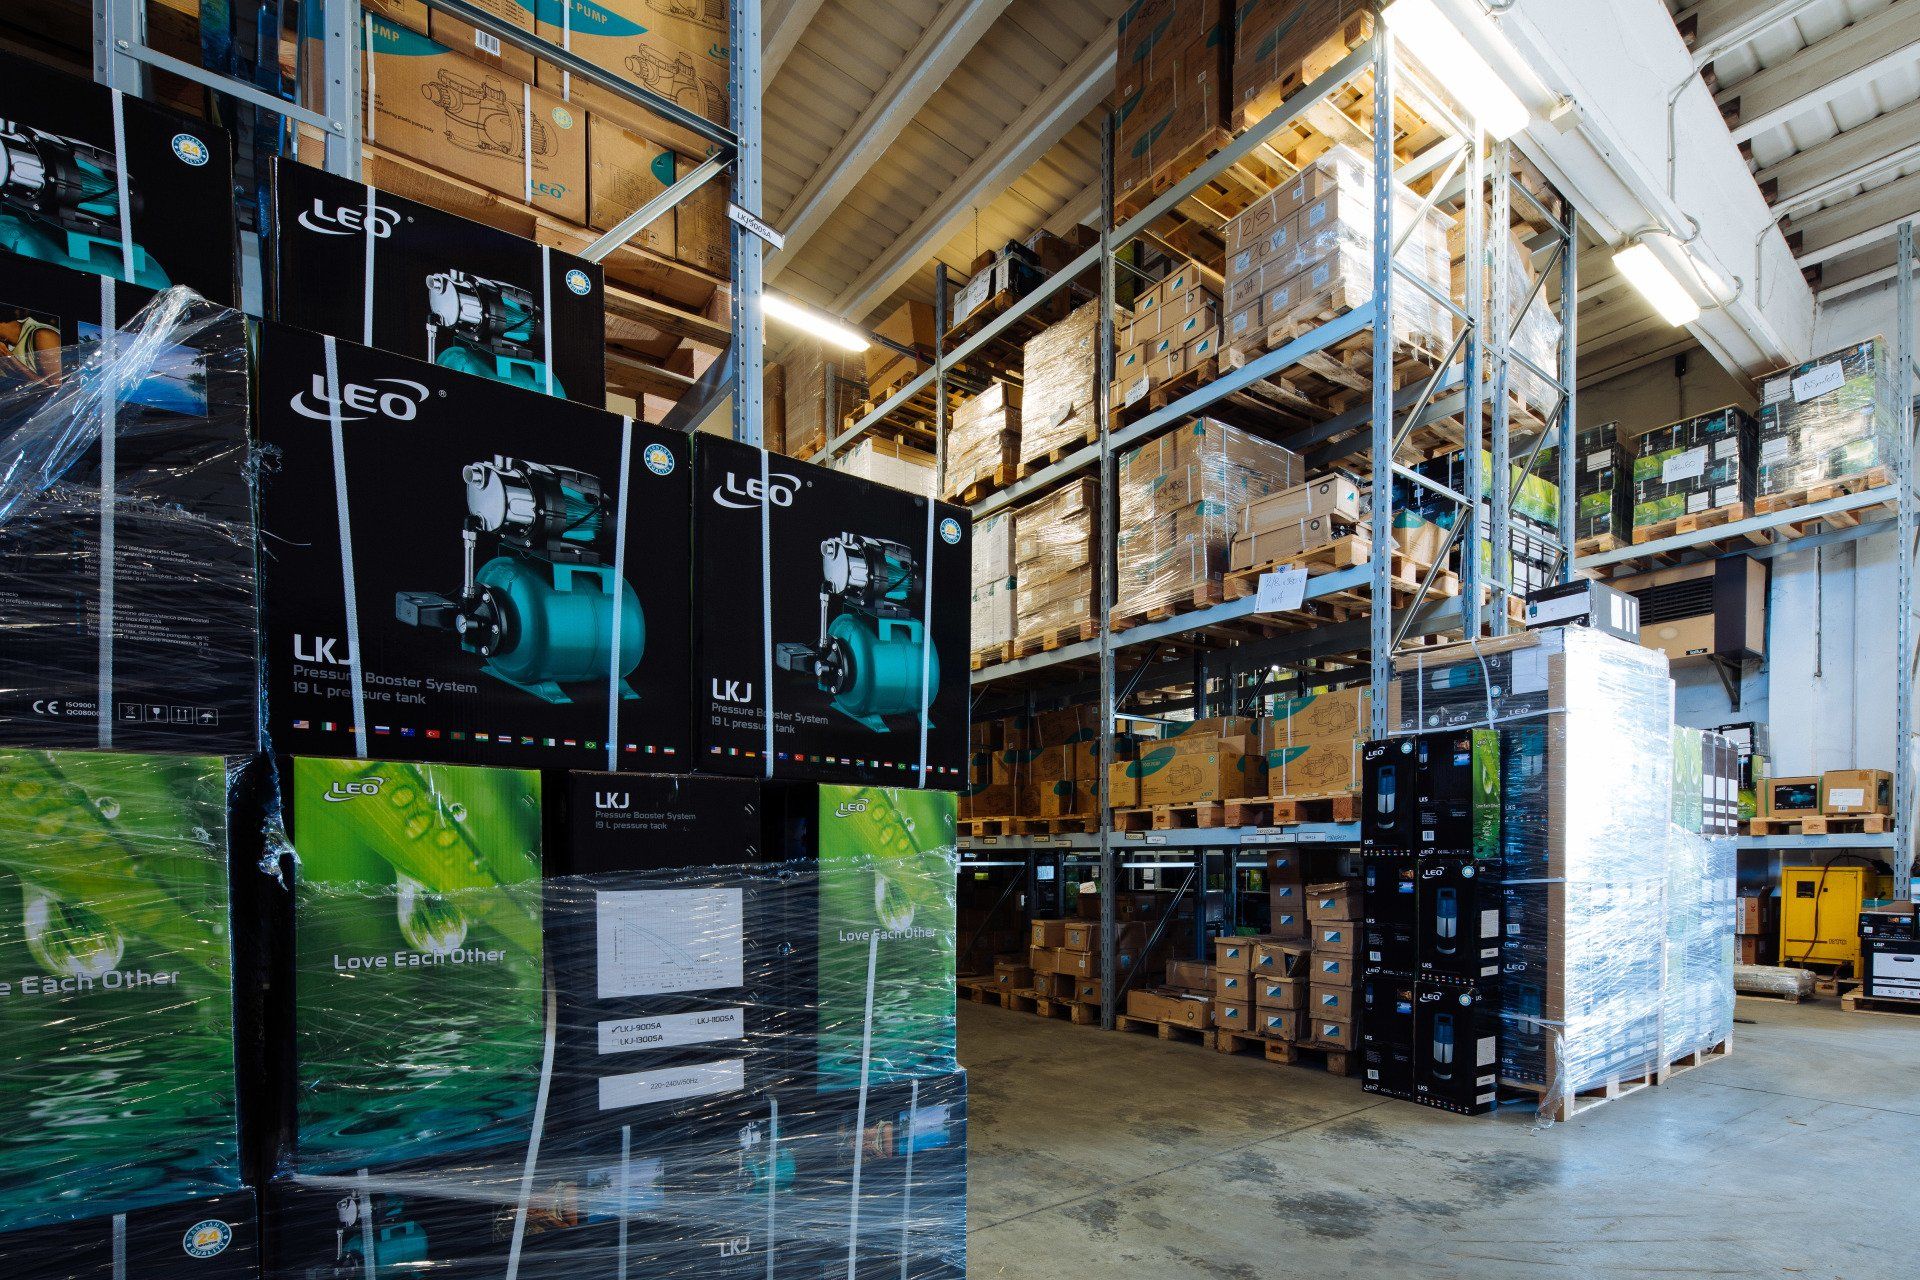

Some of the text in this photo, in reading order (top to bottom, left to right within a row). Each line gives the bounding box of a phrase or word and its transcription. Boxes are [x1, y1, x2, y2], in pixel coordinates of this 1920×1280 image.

[576, 3, 608, 25] PUMP
[313, 198, 395, 239] LEO
[312, 374, 417, 421] LEO
[727, 471, 793, 507] LEO
[293, 664, 478, 694] Pressur Booster System
[293, 682, 426, 704] 19 L presure tank
[712, 677, 752, 703] LKJ
[711, 702, 829, 725] Pressure Boster System
[1449, 715, 1467, 723] LEO
[1509, 707, 1529, 716] LEO
[711, 716, 795, 734] 19 L pressur tank
[1368, 748, 1385, 758] LEO
[332, 782, 380, 796] LEO
[595, 791, 630, 809] LKJ
[840, 802, 867, 813] LEO
[595, 811, 697, 822] Pressure Booster System
[595, 821, 668, 830] 19 L pressure tank
[1425, 868, 1443, 877] LEO
[839, 926, 935, 942] Love Each Other
[333, 947, 507, 970] Love Each Other
[1507, 963, 1526, 972] LEO
[21, 971, 94, 995] Each
[102, 969, 181, 990] Other
[1422, 993, 1440, 1001] LEO
[620, 1022, 662, 1033] LKJ-900SA
[620, 1034, 664, 1046] LKJ-1300SA
[197, 1230, 218, 1244] 24
[720, 1236, 750, 1258] LKJ
